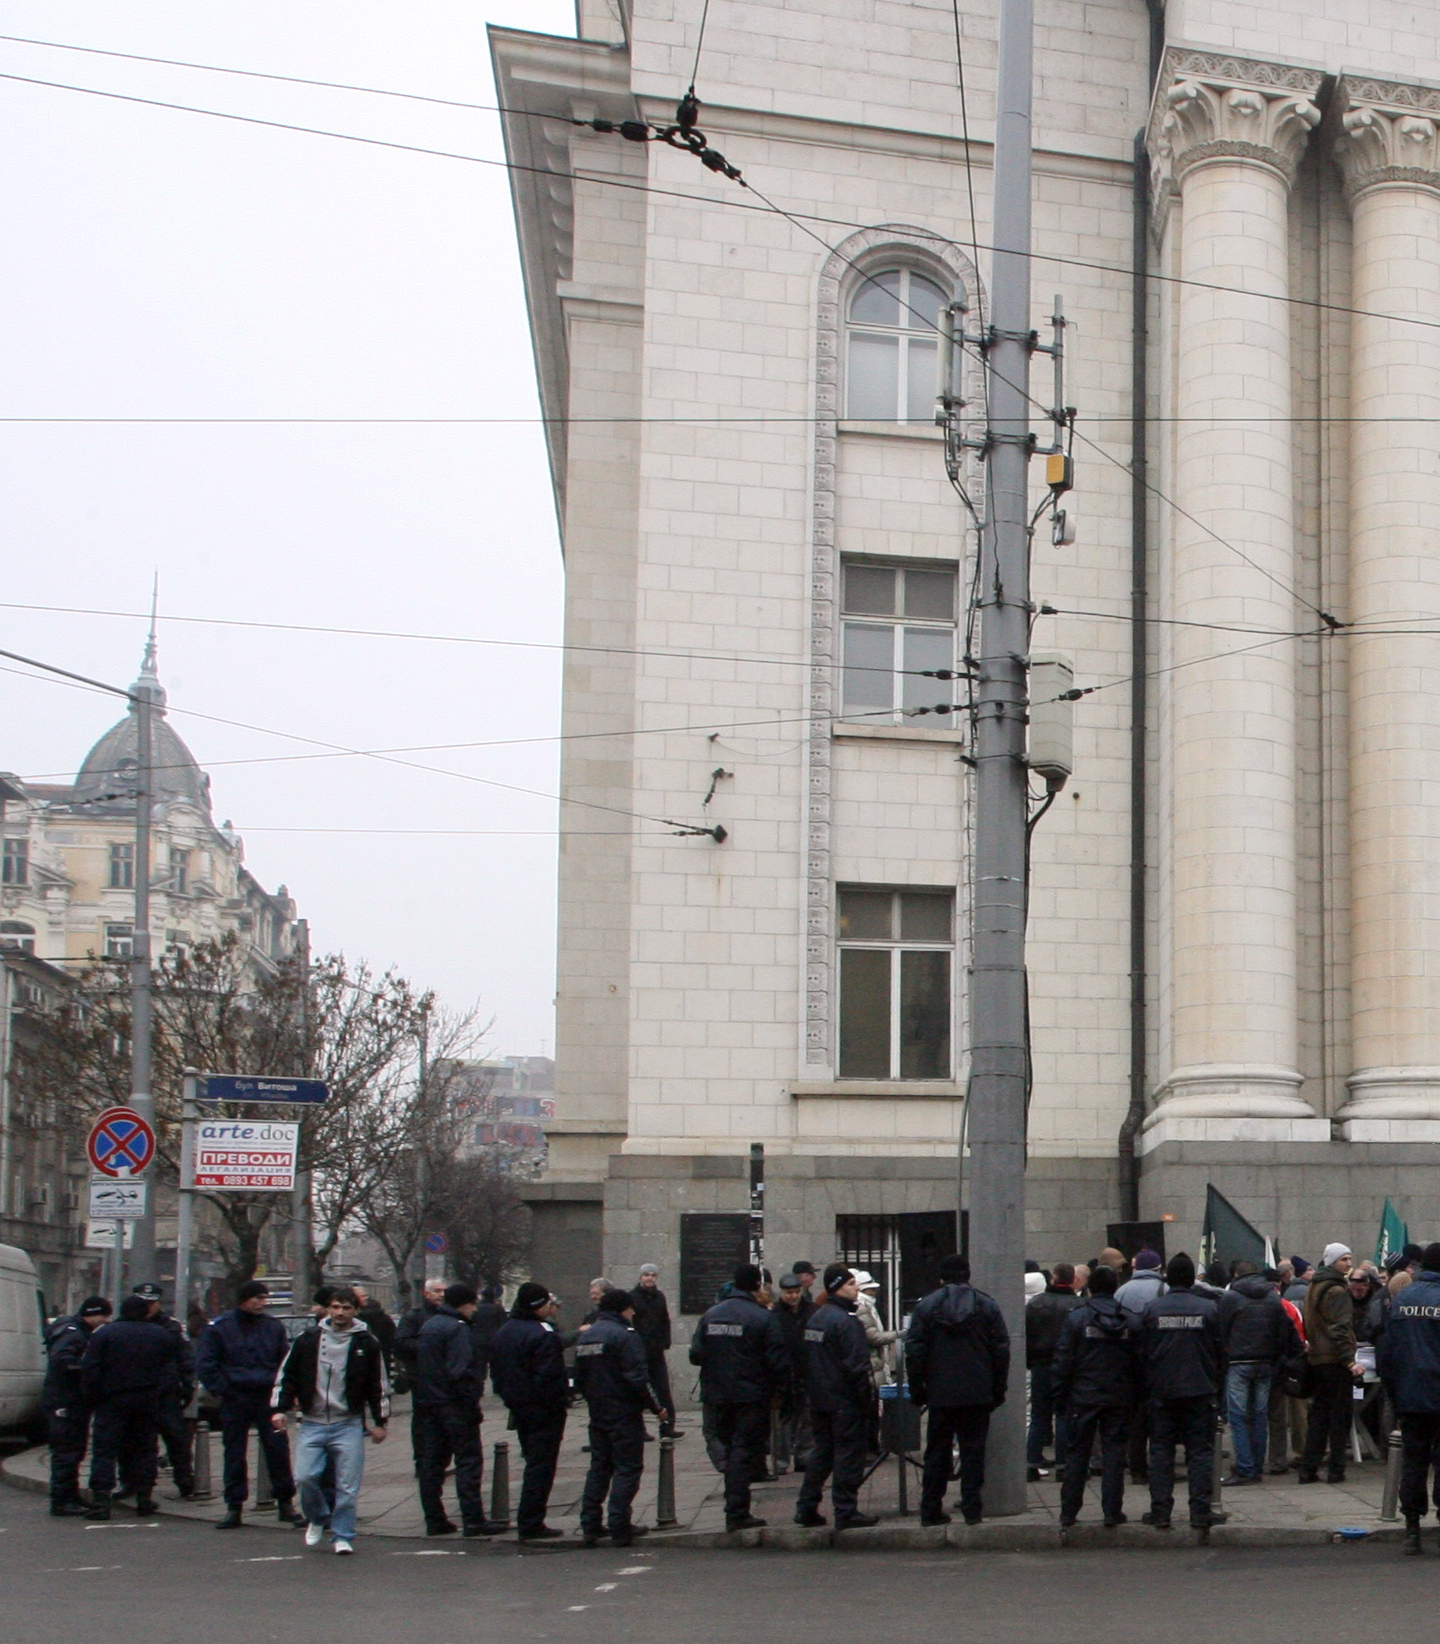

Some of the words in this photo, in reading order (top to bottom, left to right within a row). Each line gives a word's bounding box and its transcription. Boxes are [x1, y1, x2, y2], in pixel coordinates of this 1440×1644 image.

[258, 1082, 298, 1092] Витоша
[202, 1124, 295, 1140] arte.doc
[202, 1152, 291, 1165] ПРЕВОДИ
[200, 1177, 219, 1185] тел.
[250, 1177, 269, 1185] 457
